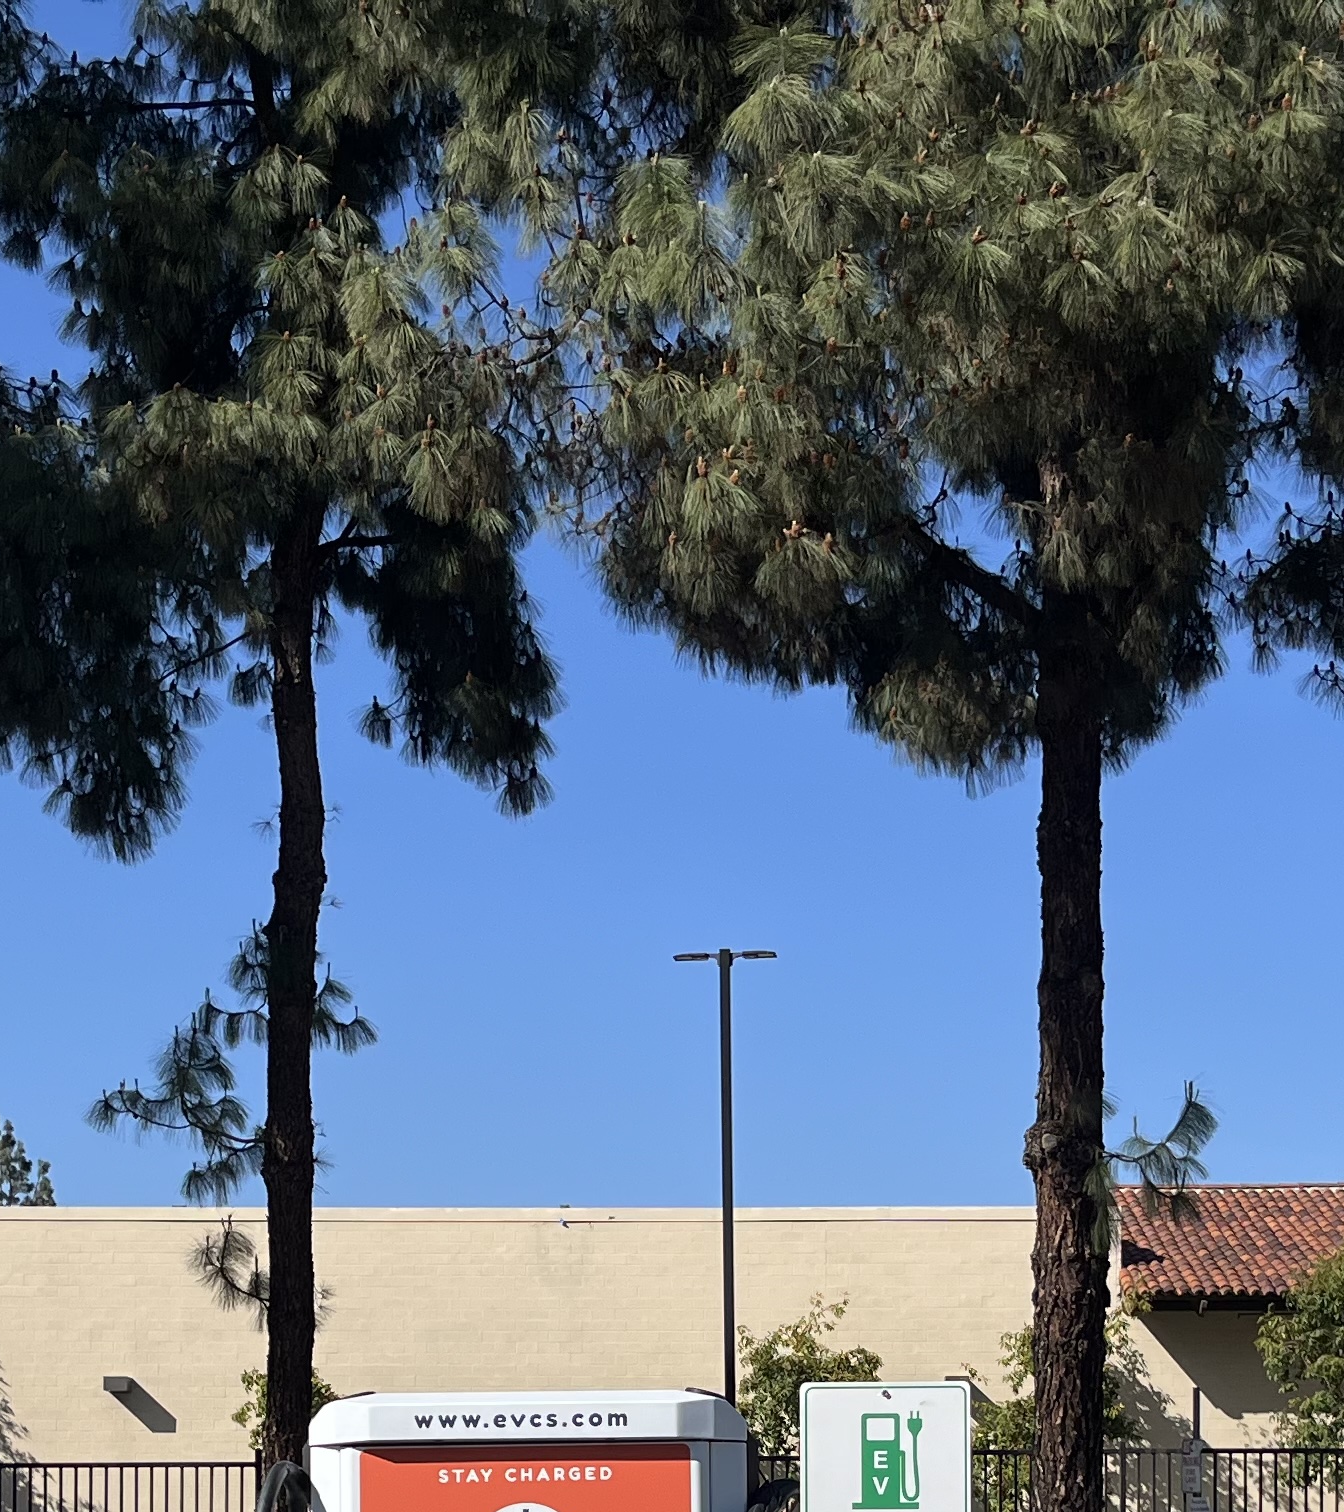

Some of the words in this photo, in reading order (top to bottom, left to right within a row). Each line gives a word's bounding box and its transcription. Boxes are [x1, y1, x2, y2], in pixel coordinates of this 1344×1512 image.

[414, 1412, 628, 1429] www.evcs.com
[438, 1468, 493, 1484] STAY
[504, 1466, 613, 1482] CHARGED
